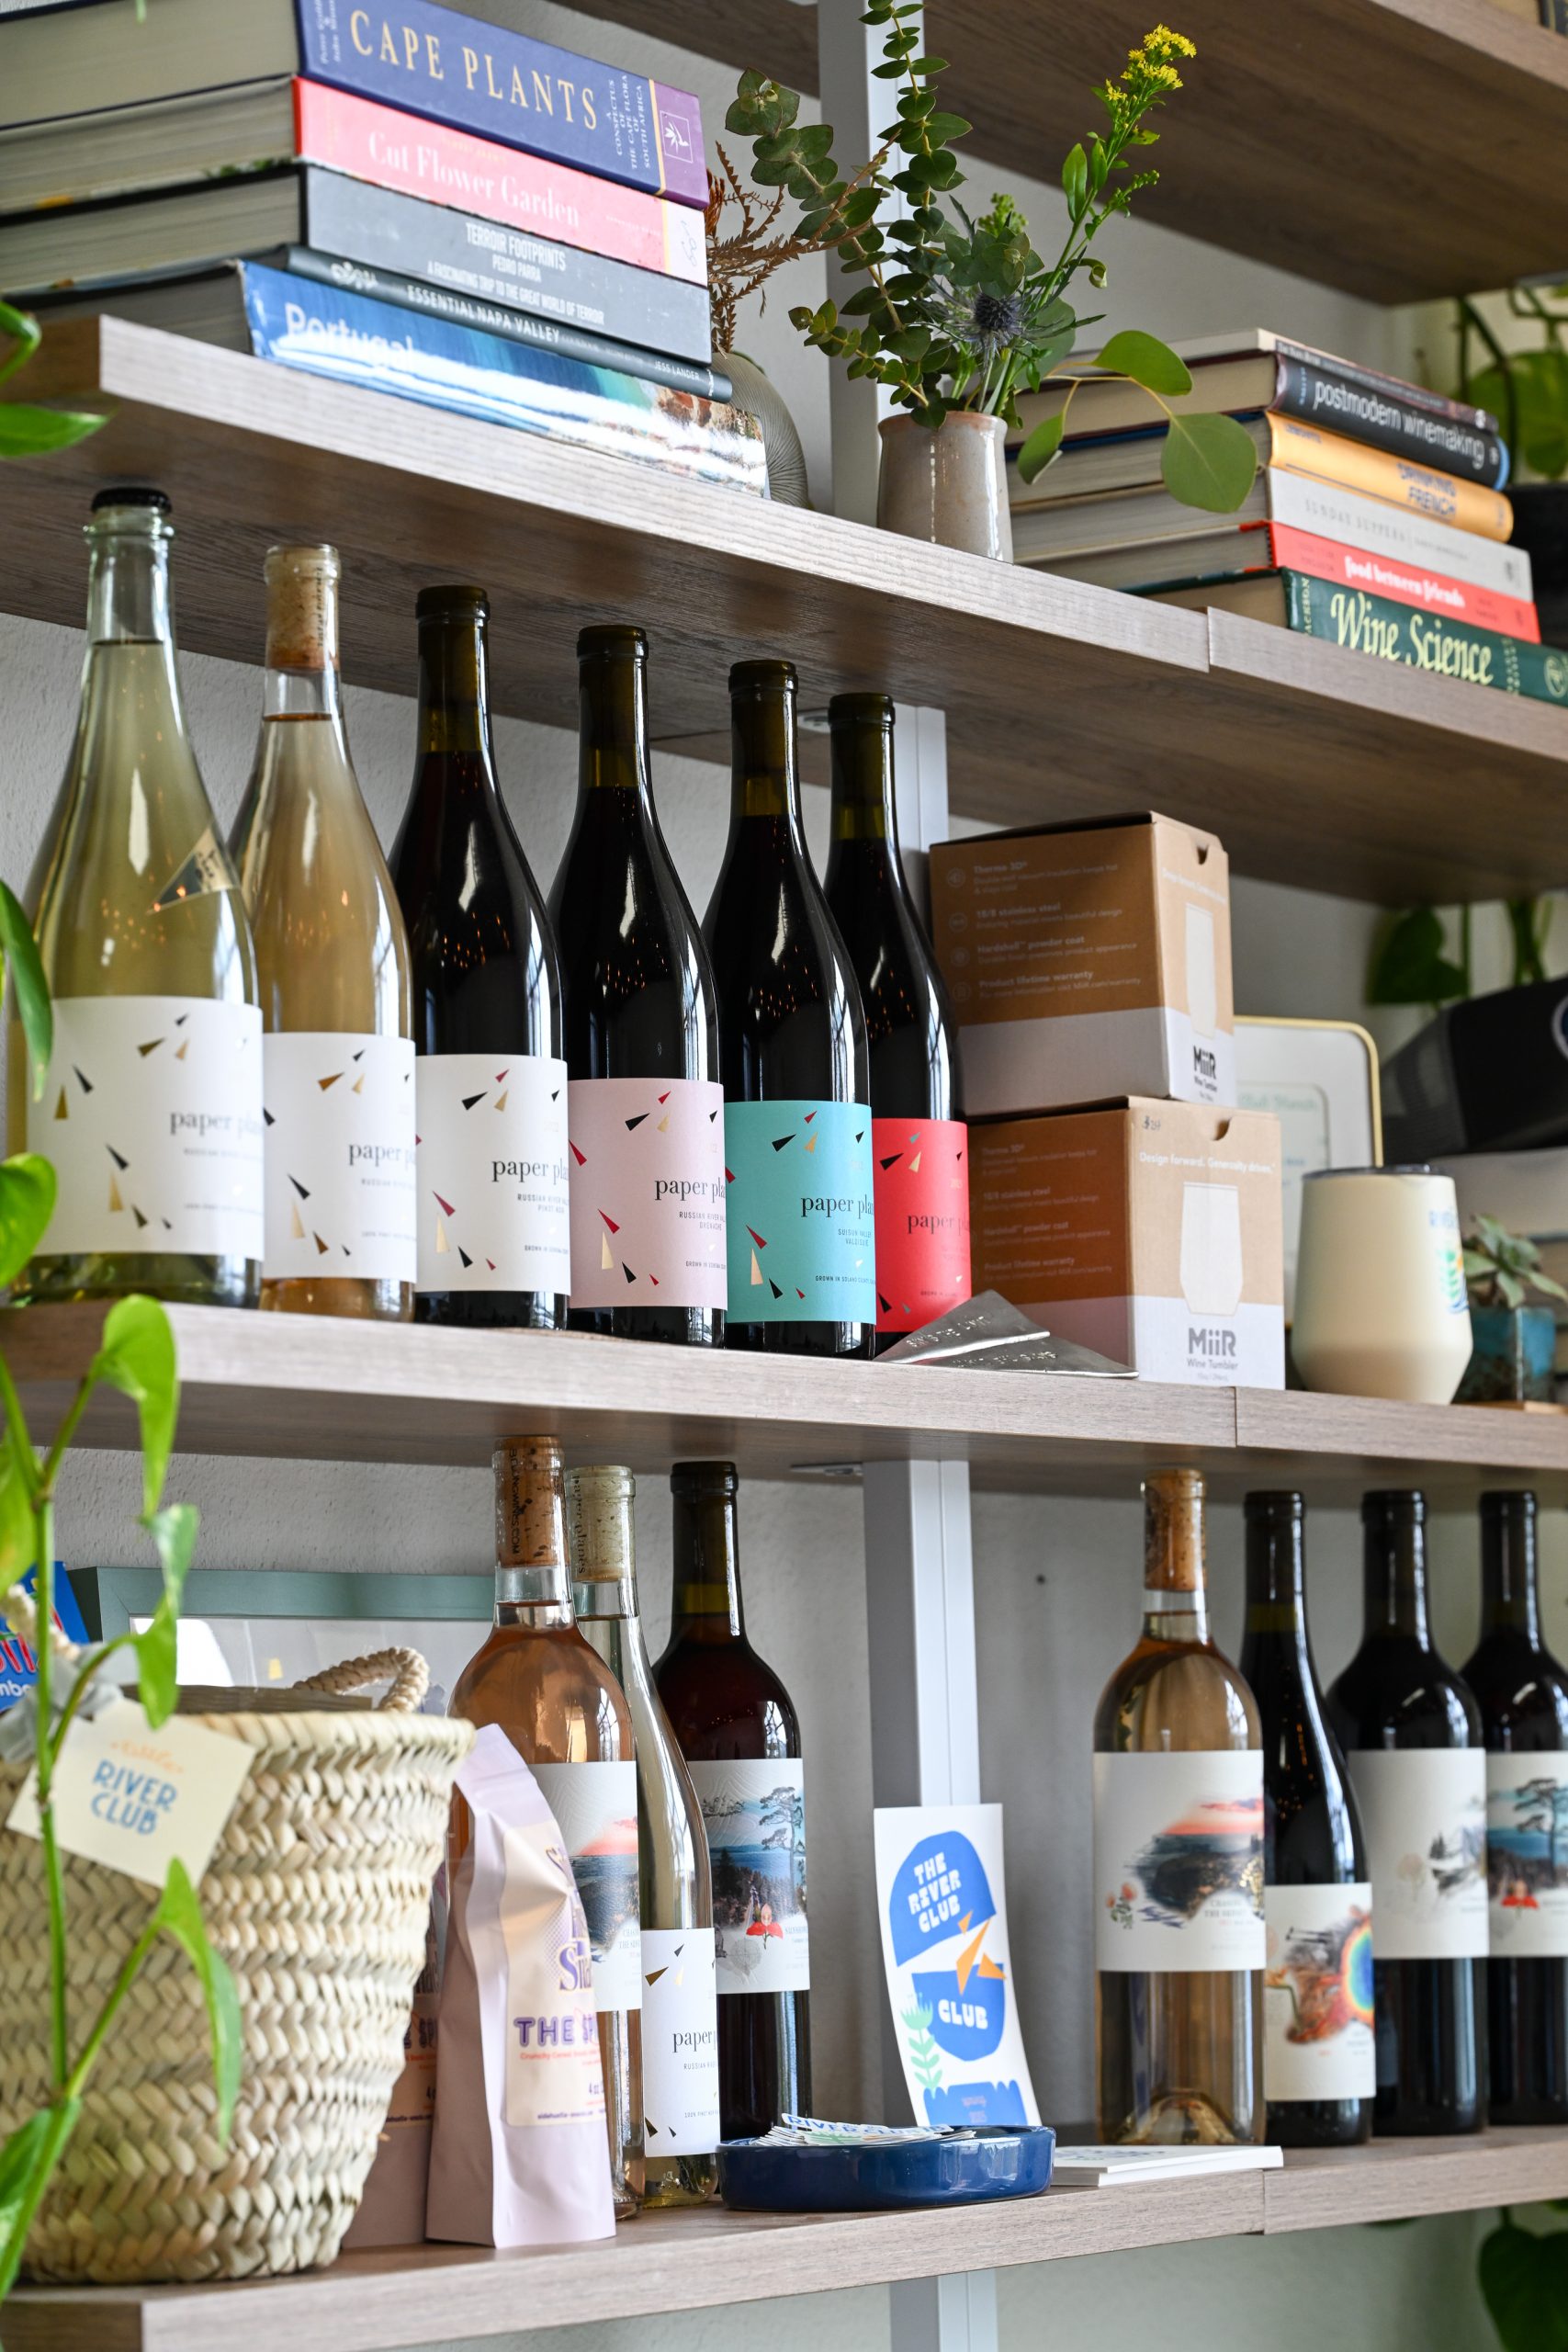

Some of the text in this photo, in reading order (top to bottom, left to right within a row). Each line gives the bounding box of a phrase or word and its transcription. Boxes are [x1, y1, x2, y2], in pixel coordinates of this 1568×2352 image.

[350, 9, 597, 131] CAPE PLANTS
[608, 79, 623, 156] CONSPECTUS
[618, 111, 626, 129] OF
[621, 74, 637, 170] THE CAPE FLORA
[632, 116, 639, 133] OF
[636, 85, 650, 169] SOUTH AFRICA
[368, 130, 410, 174] Cut
[416, 145, 496, 201] Flower
[501, 174, 581, 229] Garden
[465, 221, 567, 272] TERROIR FOOTPRINTS
[491, 254, 516, 277] PEDRO
[407, 284, 560, 343] ESSENTIAL NAPA VALLEY
[518, 285, 541, 308] GREAT
[541, 292, 566, 314] WORLD
[566, 300, 577, 317] OF
[576, 303, 605, 326] TERROIR
[653, 360, 701, 382] JESS LANDER
[1312, 379, 1402, 433] postmodern
[1401, 410, 1486, 470] winemaking
[1303, 576, 1312, 636] ACKSON
[1330, 591, 1402, 663] Wine
[1404, 613, 1495, 687] Science
[171, 1113, 231, 1136] paper
[348, 1143, 400, 1168] paper
[491, 1159, 549, 1183] paper
[1138, 1150, 1169, 1167] Design
[1170, 1153, 1206, 1168] forward.
[654, 1179, 708, 1202] paper
[679, 1211, 705, 1220] RUSSIAN
[800, 1196, 854, 1218] paper
[908, 1214, 955, 1236] paper
[1188, 1327, 1237, 1357] MiiR
[1187, 1357, 1239, 1371] Wine Tumbler
[92, 1758, 179, 1814] RIVER
[90, 1792, 159, 1837] CLUB
[913, 1851, 947, 1885] THE
[908, 1868, 962, 1916] RIVER
[918, 1894, 961, 1934] CLUB
[937, 1998, 989, 2030] CLUB
[513, 2016, 575, 2048] THE
[672, 2030, 713, 2053] paper
[787, 2115, 857, 2133] RIVER
